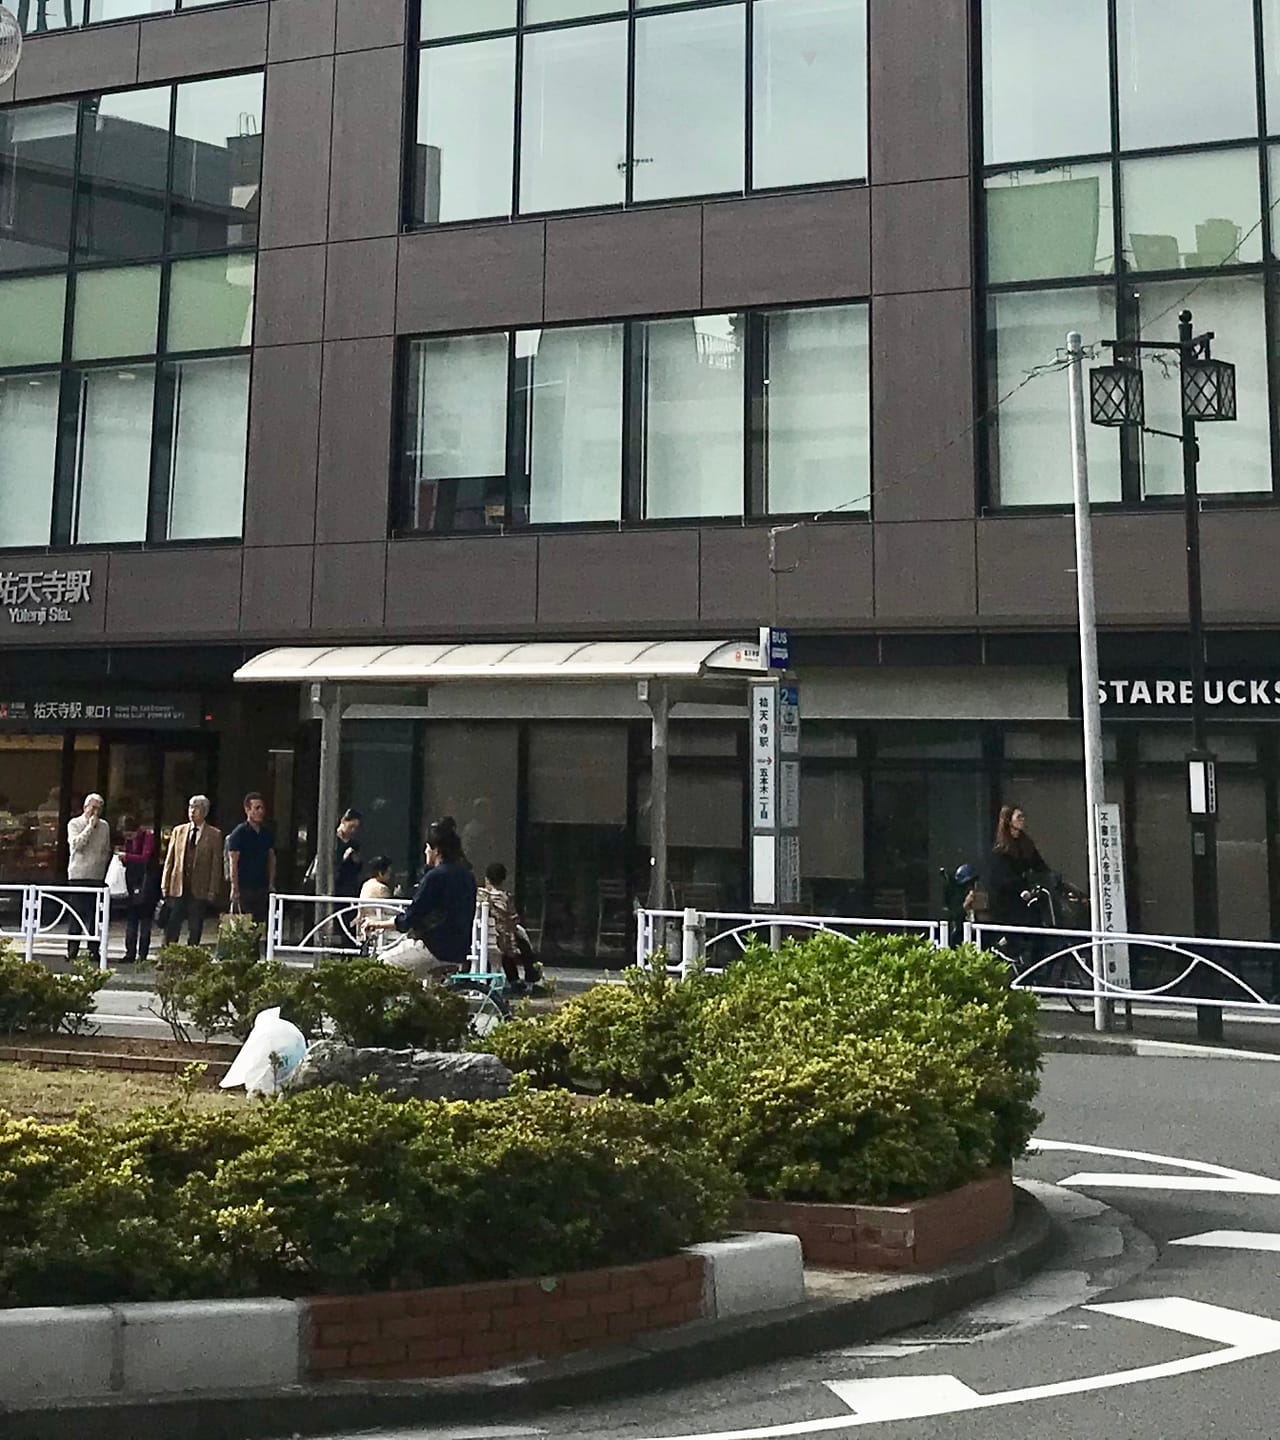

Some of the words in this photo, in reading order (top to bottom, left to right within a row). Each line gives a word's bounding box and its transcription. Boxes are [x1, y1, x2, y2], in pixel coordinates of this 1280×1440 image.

[772, 631, 787, 644] BUS
[780, 688, 789, 705] 2
[33, 701, 82, 719] 祐天寺駅
[759, 697, 768, 748] 祐天寺駅
